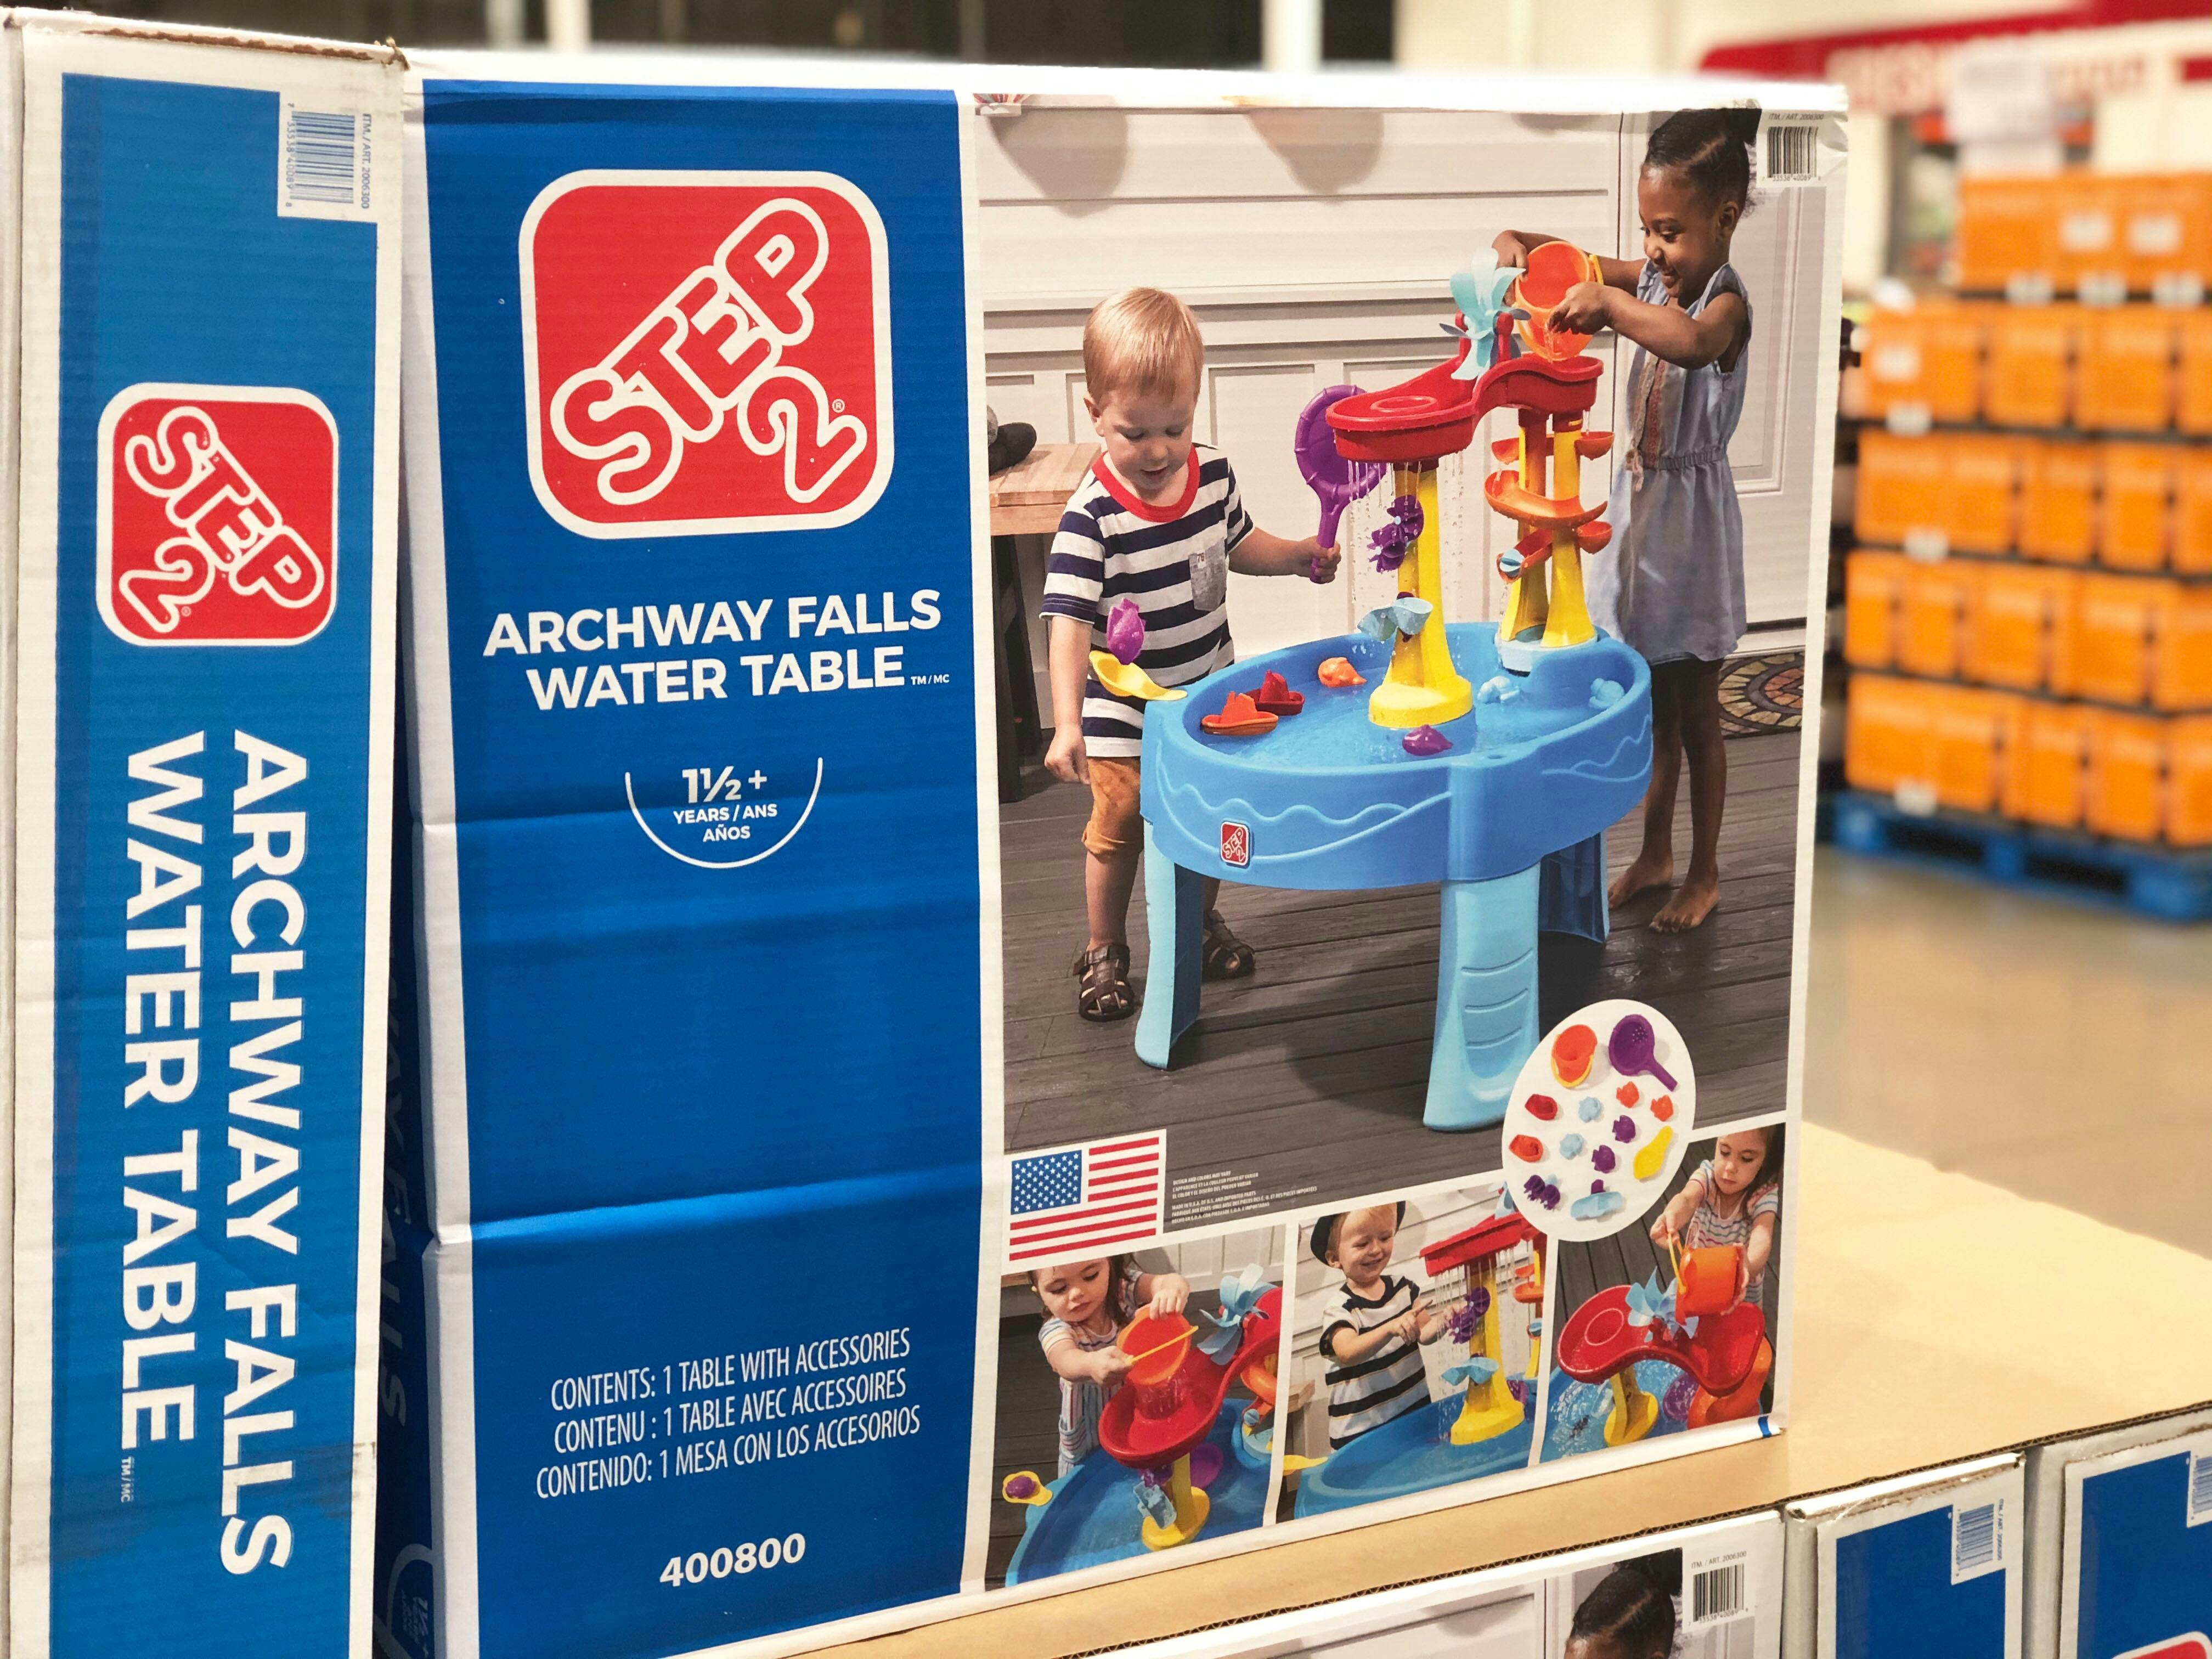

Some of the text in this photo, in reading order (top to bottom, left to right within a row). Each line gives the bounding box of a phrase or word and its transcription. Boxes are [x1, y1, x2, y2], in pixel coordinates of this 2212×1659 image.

[361, 167, 371, 210] 2006300
[550, 198, 829, 506] STEP
[125, 406, 325, 608] STEP
[483, 589, 941, 656] ARCHWAY FALLS
[526, 658, 728, 710] WATER
[740, 646, 905, 696] TABLE
[673, 804, 777, 824] YEARS / ANS
[703, 824, 751, 842] AÑOS
[1222, 827, 1243, 859] STEP
[124, 730, 205, 1108] WATER
[220, 729, 307, 1576] ARCHWAY FALLS
[122, 1128, 199, 1449] TABLE
[551, 1327, 911, 1411] CONTENTS: 1 TABLE WITH ACCESSORIES
[554, 1410, 646, 1453] CONTENU
[663, 1408, 672, 1437] 1
[679, 1395, 735, 1434] TABLE
[740, 1387, 786, 1424] AVEC
[791, 1367, 906, 1416] ACCESSOIRES
[536, 1404, 921, 1499] CONTENIDO: 1 MESA CON LOS ACCESORIOS
[659, 1533, 806, 1588] 400800
[1722, 1550, 1747, 1562] 2006300
